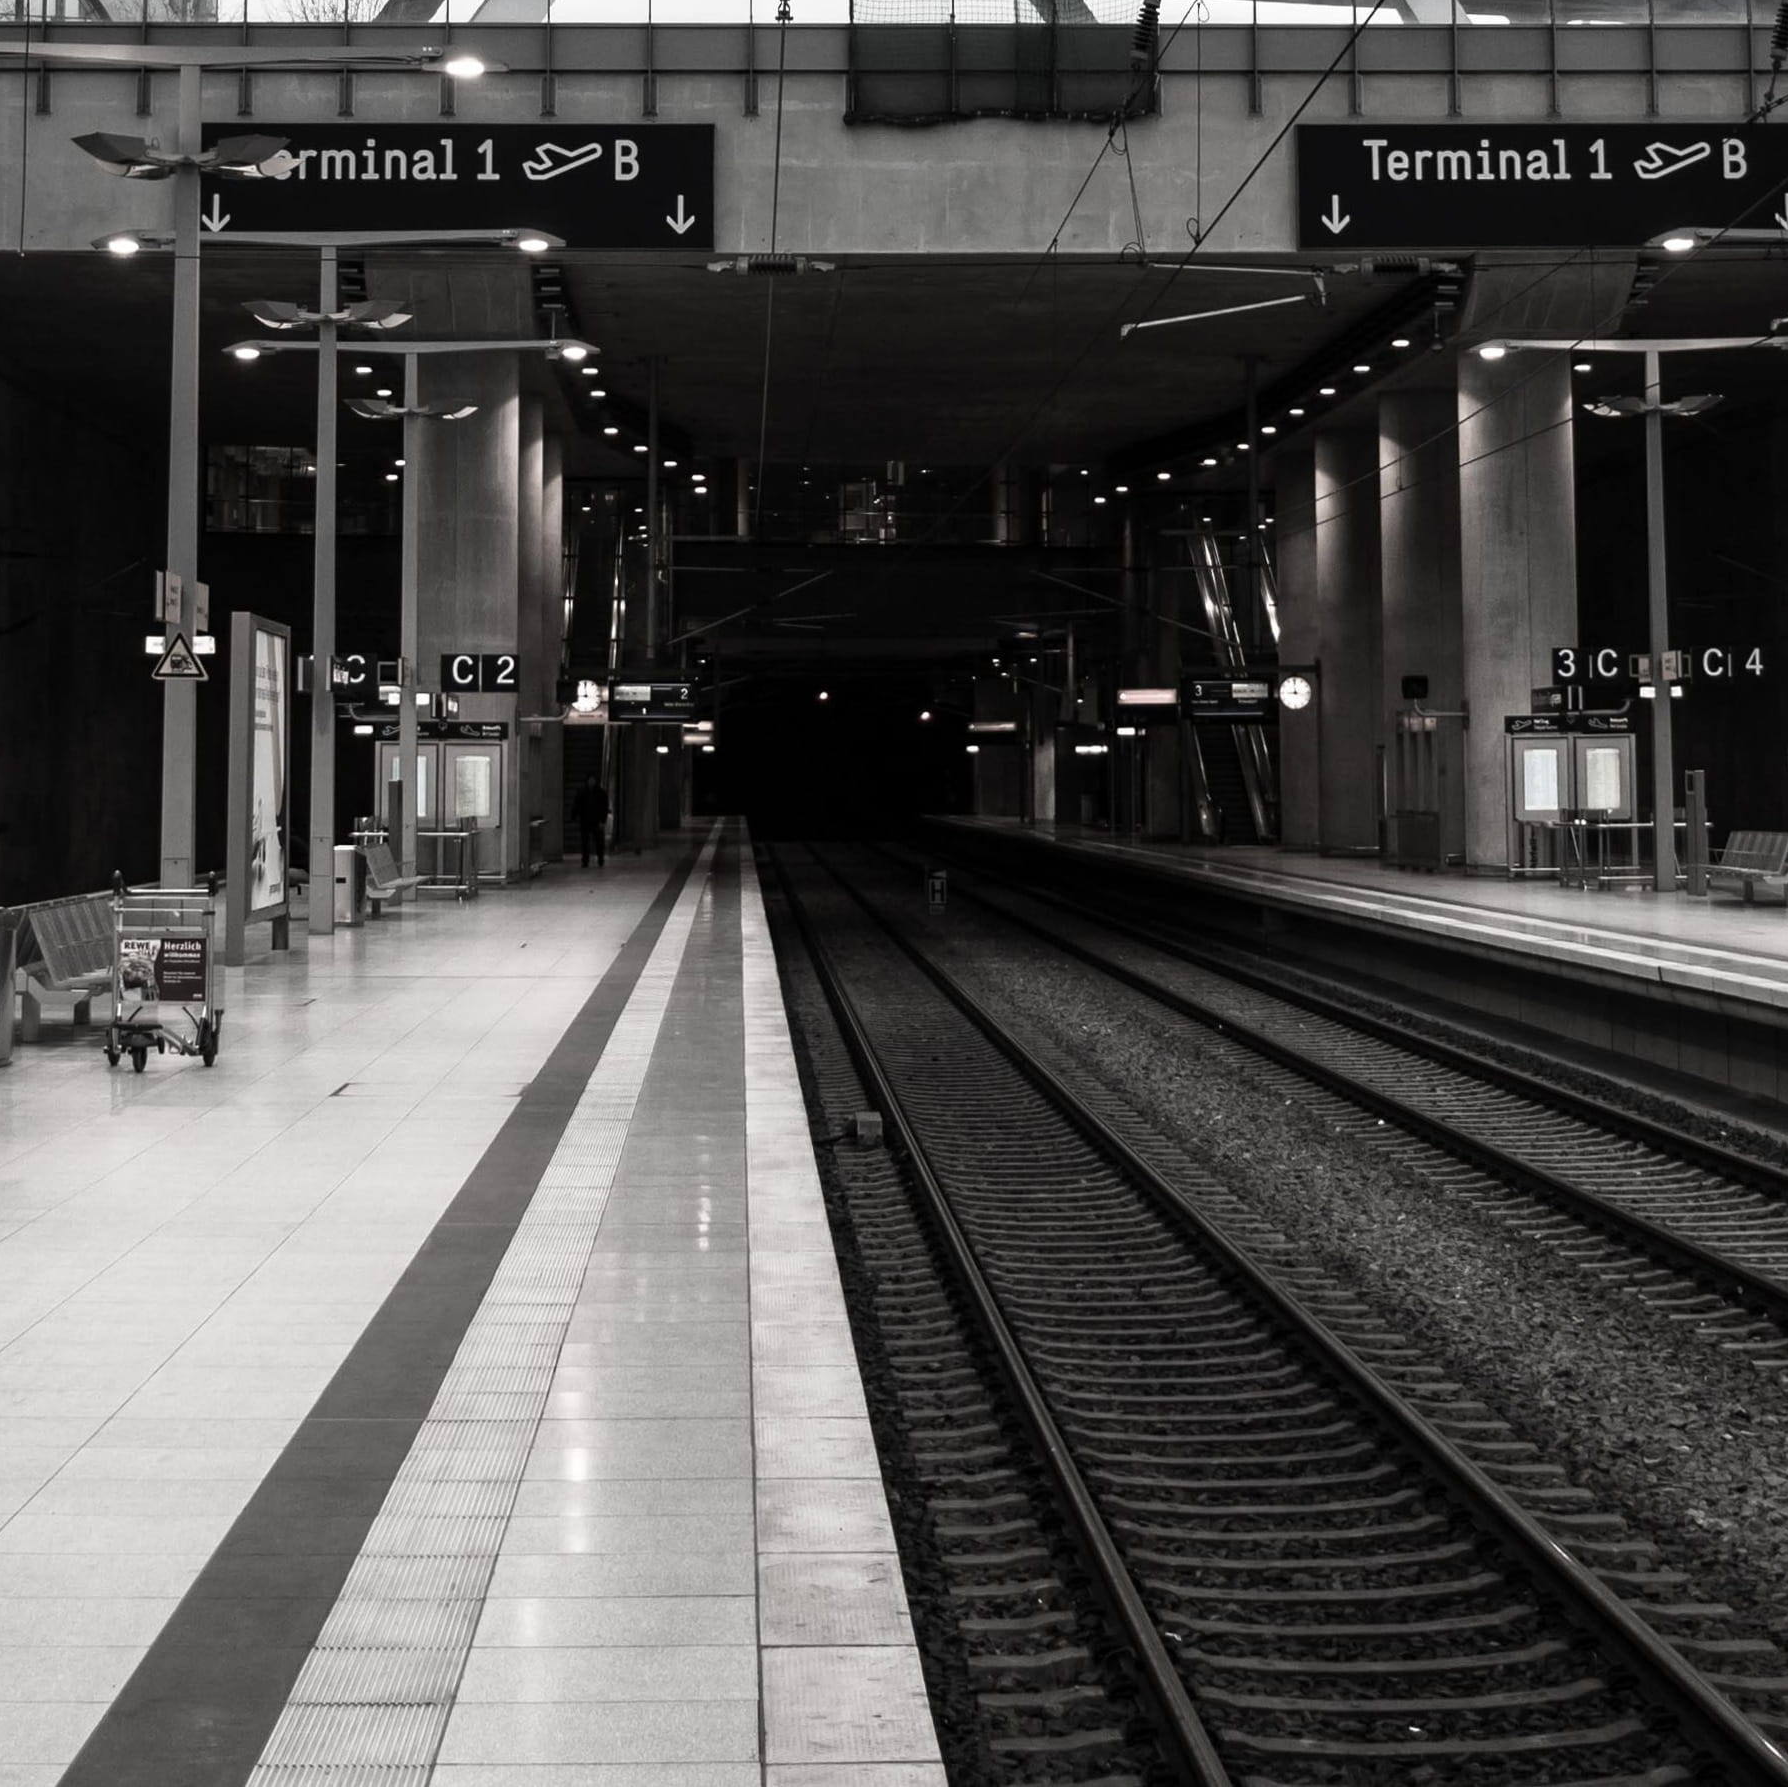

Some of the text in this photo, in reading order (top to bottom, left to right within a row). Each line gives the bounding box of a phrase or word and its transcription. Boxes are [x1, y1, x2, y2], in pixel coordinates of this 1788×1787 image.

[476, 138, 501, 181] 1
[614, 139, 640, 181] B
[1362, 138, 1748, 181] Terminal 1 B
[452, 655, 516, 684] C 2
[1557, 648, 1618, 677] 3 C
[1702, 647, 1764, 677] C 4
[680, 687, 690, 700] 2
[164, 941, 202, 951] Herzlich
